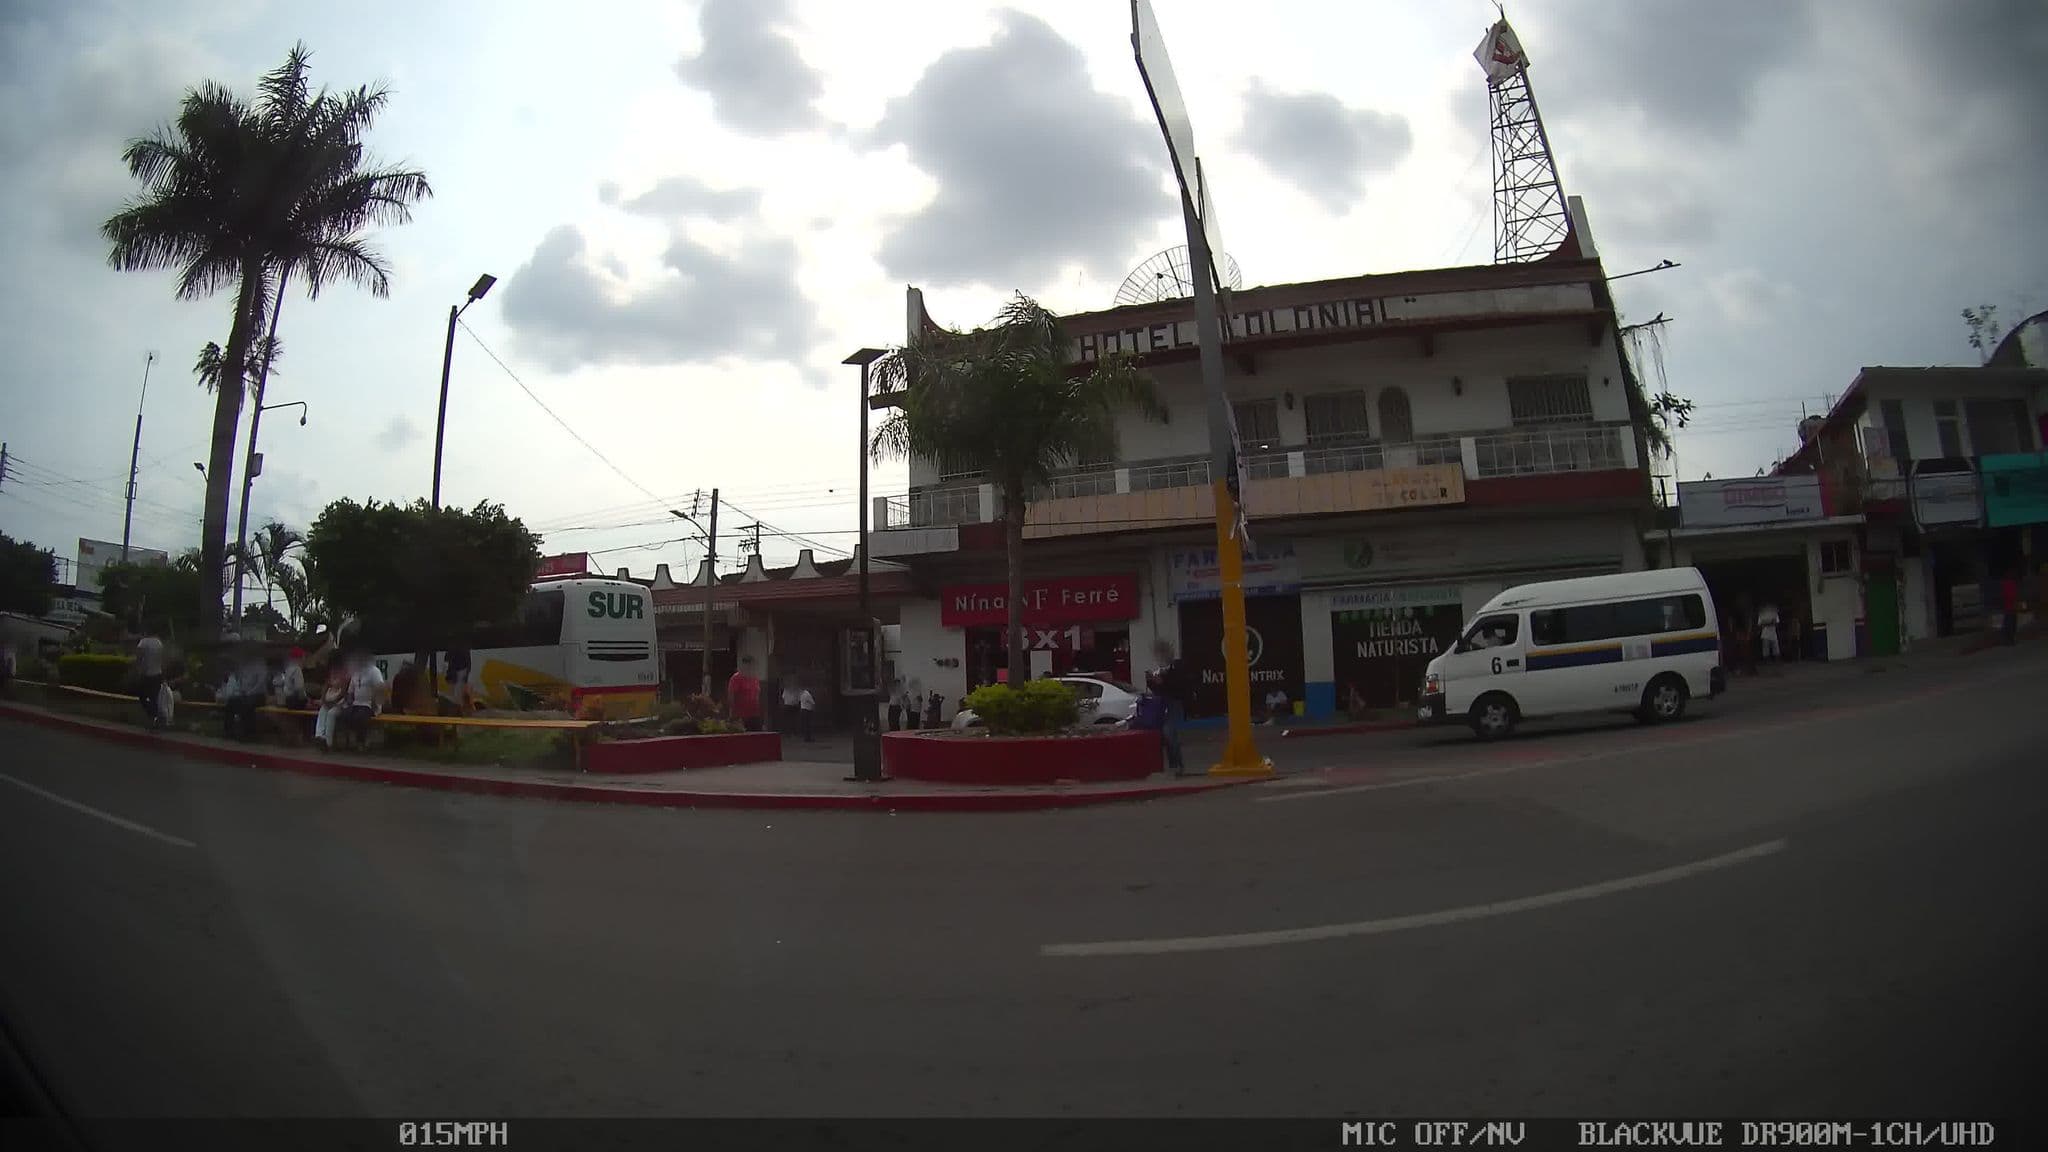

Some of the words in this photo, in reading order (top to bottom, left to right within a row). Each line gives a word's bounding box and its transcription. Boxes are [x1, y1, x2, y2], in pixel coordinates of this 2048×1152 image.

[1079, 321, 1194, 362] HOTEL
[1220, 296, 1402, 342] COLONIAL
[587, 591, 644, 619] SUR
[1062, 584, 1119, 606] Ferré
[1369, 619, 1423, 638] TIENDA
[1356, 637, 1440, 659] NATURISTA
[1491, 656, 1503, 676] 6
